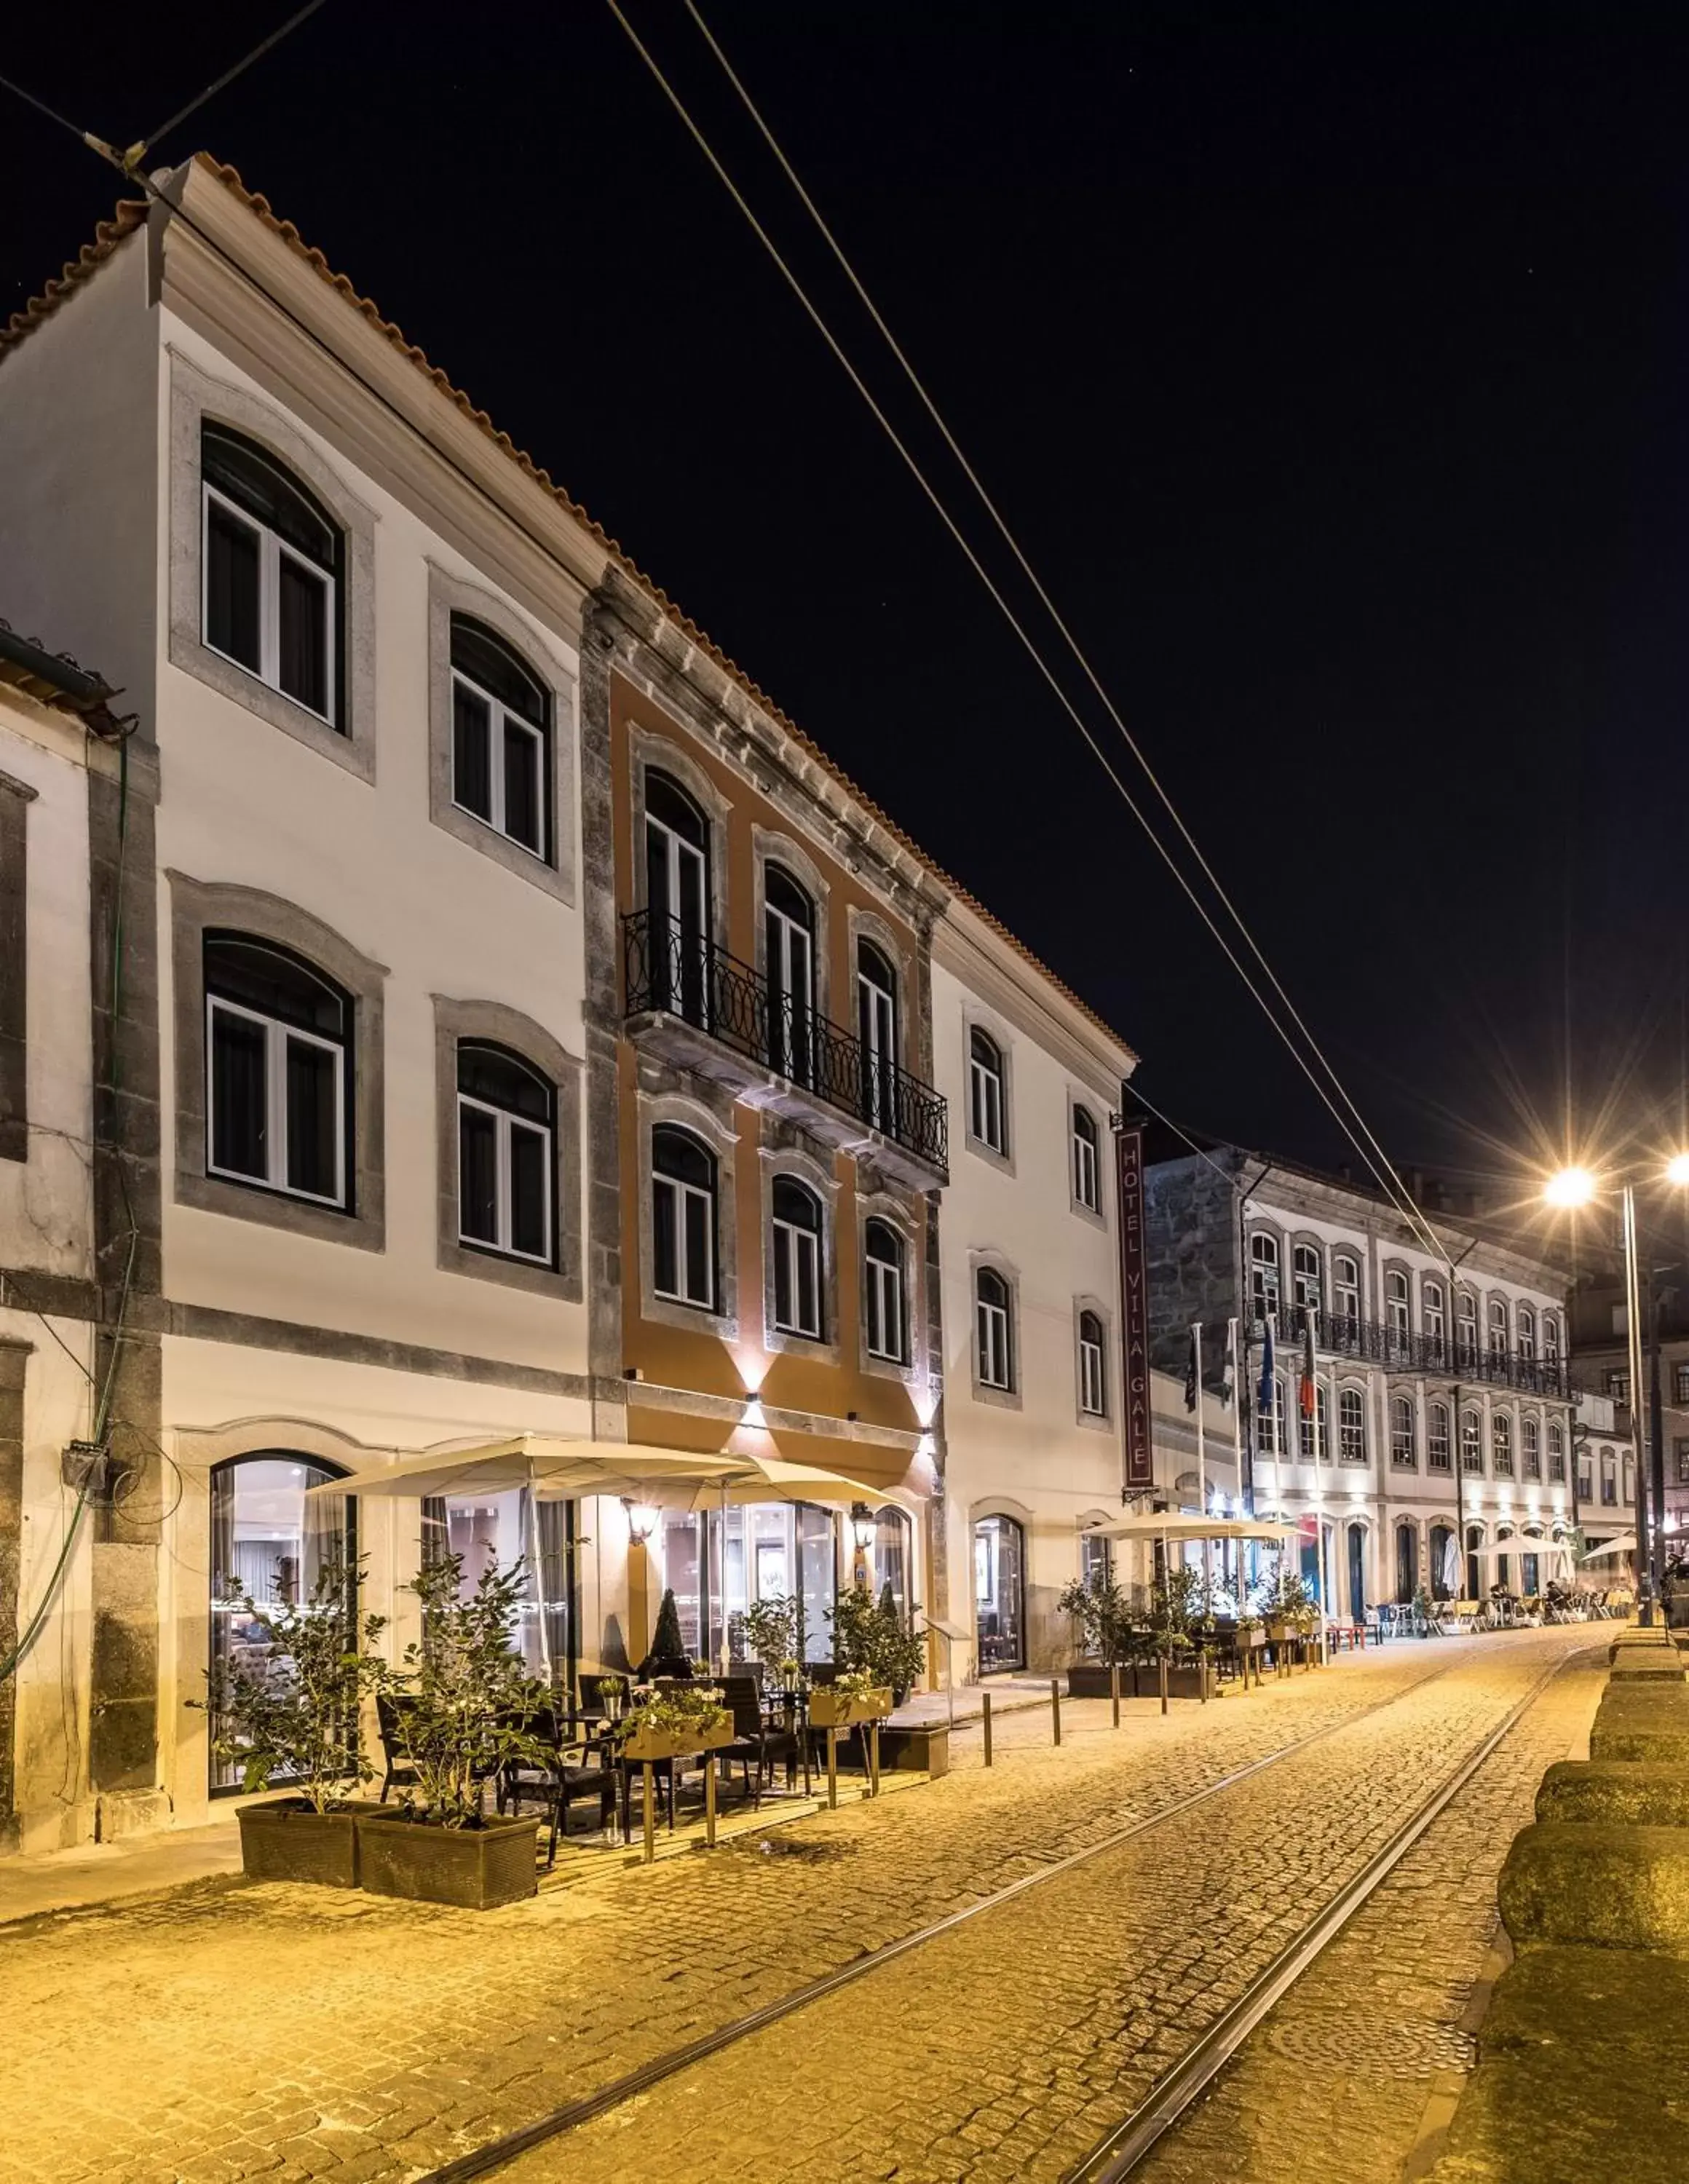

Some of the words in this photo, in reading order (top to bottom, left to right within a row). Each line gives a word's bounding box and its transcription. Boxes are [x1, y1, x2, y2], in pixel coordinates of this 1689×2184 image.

[1124, 1150, 1139, 1252] HOTEL
[1128, 1272, 1142, 1356] VILA
[1131, 1377, 1145, 1464] GALÉ
